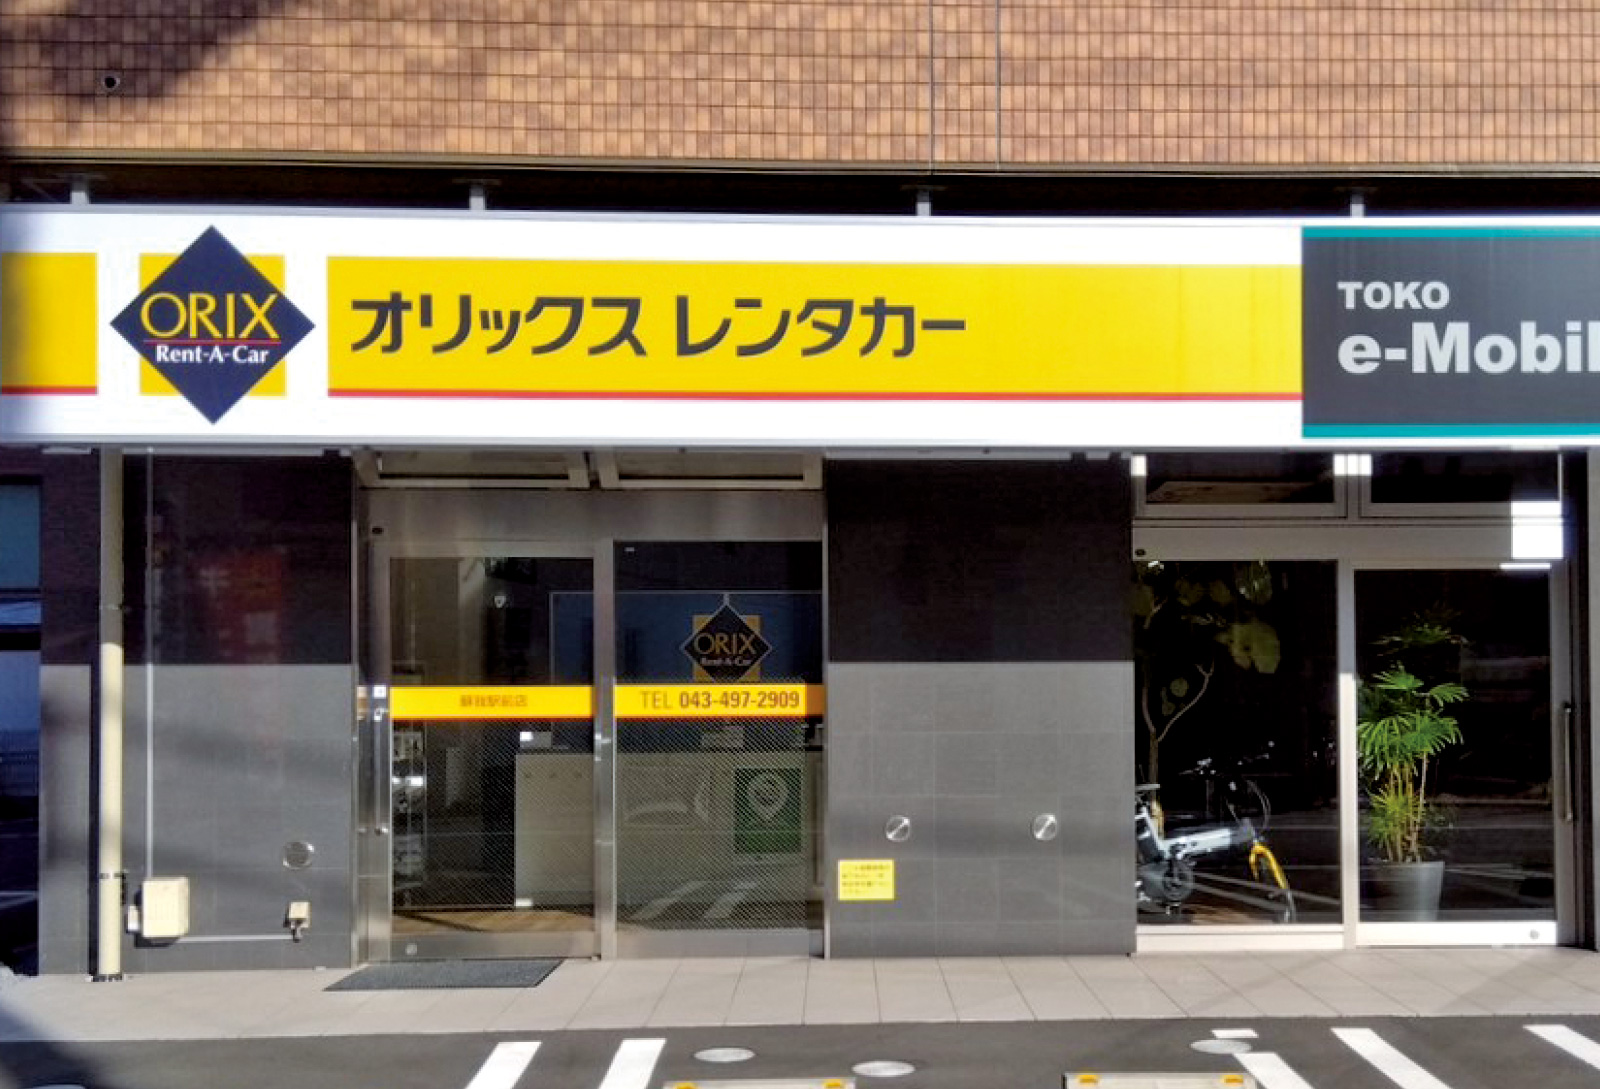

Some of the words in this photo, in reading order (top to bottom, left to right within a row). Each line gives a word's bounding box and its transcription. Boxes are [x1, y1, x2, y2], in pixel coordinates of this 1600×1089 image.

[1337, 281, 1450, 309] TOKO
[140, 291, 280, 339] ORIX
[351, 291, 647, 356] オリックス
[676, 295, 967, 357] レンタカー
[156, 344, 270, 364] Rent-A-Car
[1337, 320, 1600, 373] e-Mobil
[693, 632, 757, 655] ORIX
[640, 690, 674, 709] TEL
[680, 690, 800, 709] 043-497-2909
